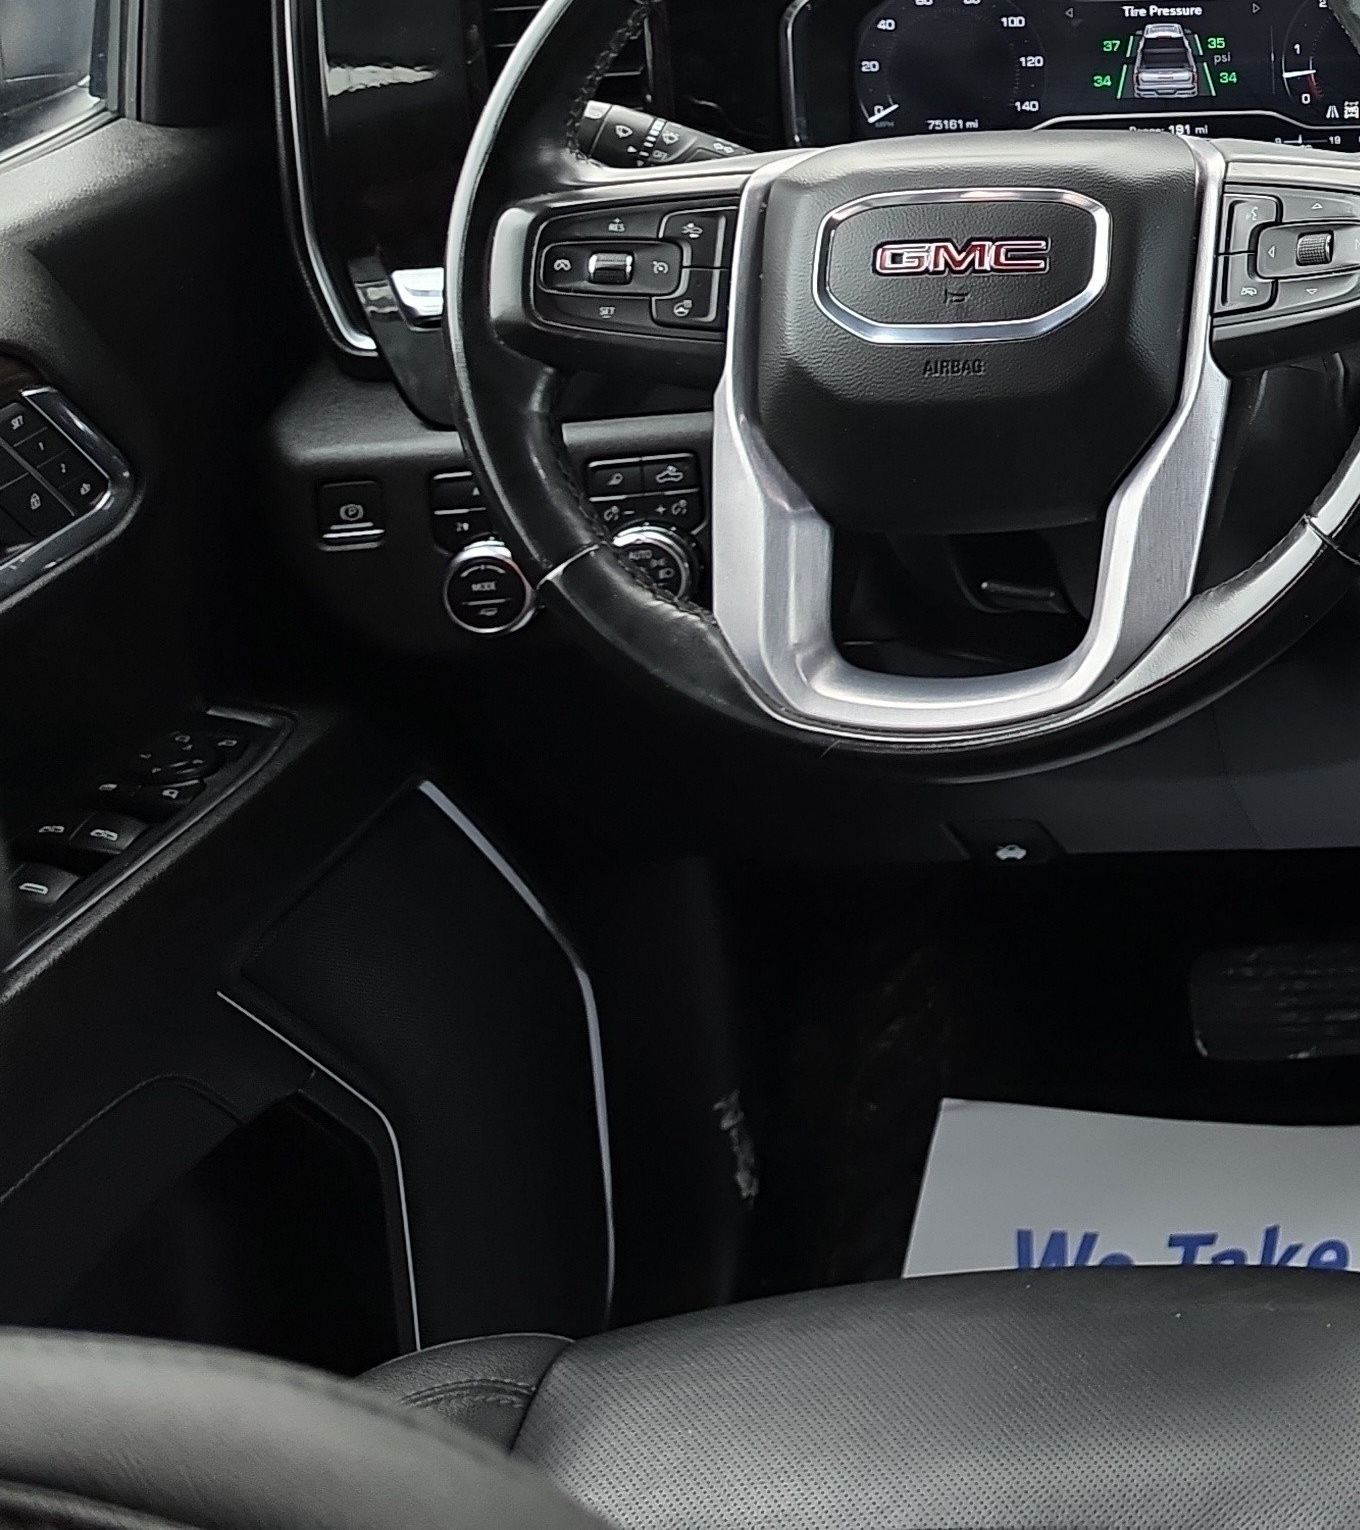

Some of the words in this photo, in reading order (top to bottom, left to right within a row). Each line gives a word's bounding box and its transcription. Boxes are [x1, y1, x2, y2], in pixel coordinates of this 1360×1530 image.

[1122, 5, 1148, 18] Tire
[1149, 5, 1202, 18] Pressure
[877, 20, 896, 31] 40
[1001, 16, 1025, 28] 100
[1103, 40, 1121, 52] 37
[1207, 37, 1226, 49] 35
[1294, 44, 1301, 55] 1
[1019, 56, 1044, 68] 120
[1213, 52, 1231, 65] psi
[861, 61, 880, 72] 20
[1092, 75, 1113, 87] 34
[1219, 72, 1238, 84] 34
[1301, 93, 1311, 105] 0
[1014, 101, 1039, 113] 140
[965, 120, 979, 130] mi
[1168, 124, 1190, 136] 191
[1195, 124, 1208, 135] mi
[874, 237, 1050, 276] GMC
[922, 358, 986, 378] AIRBAG
